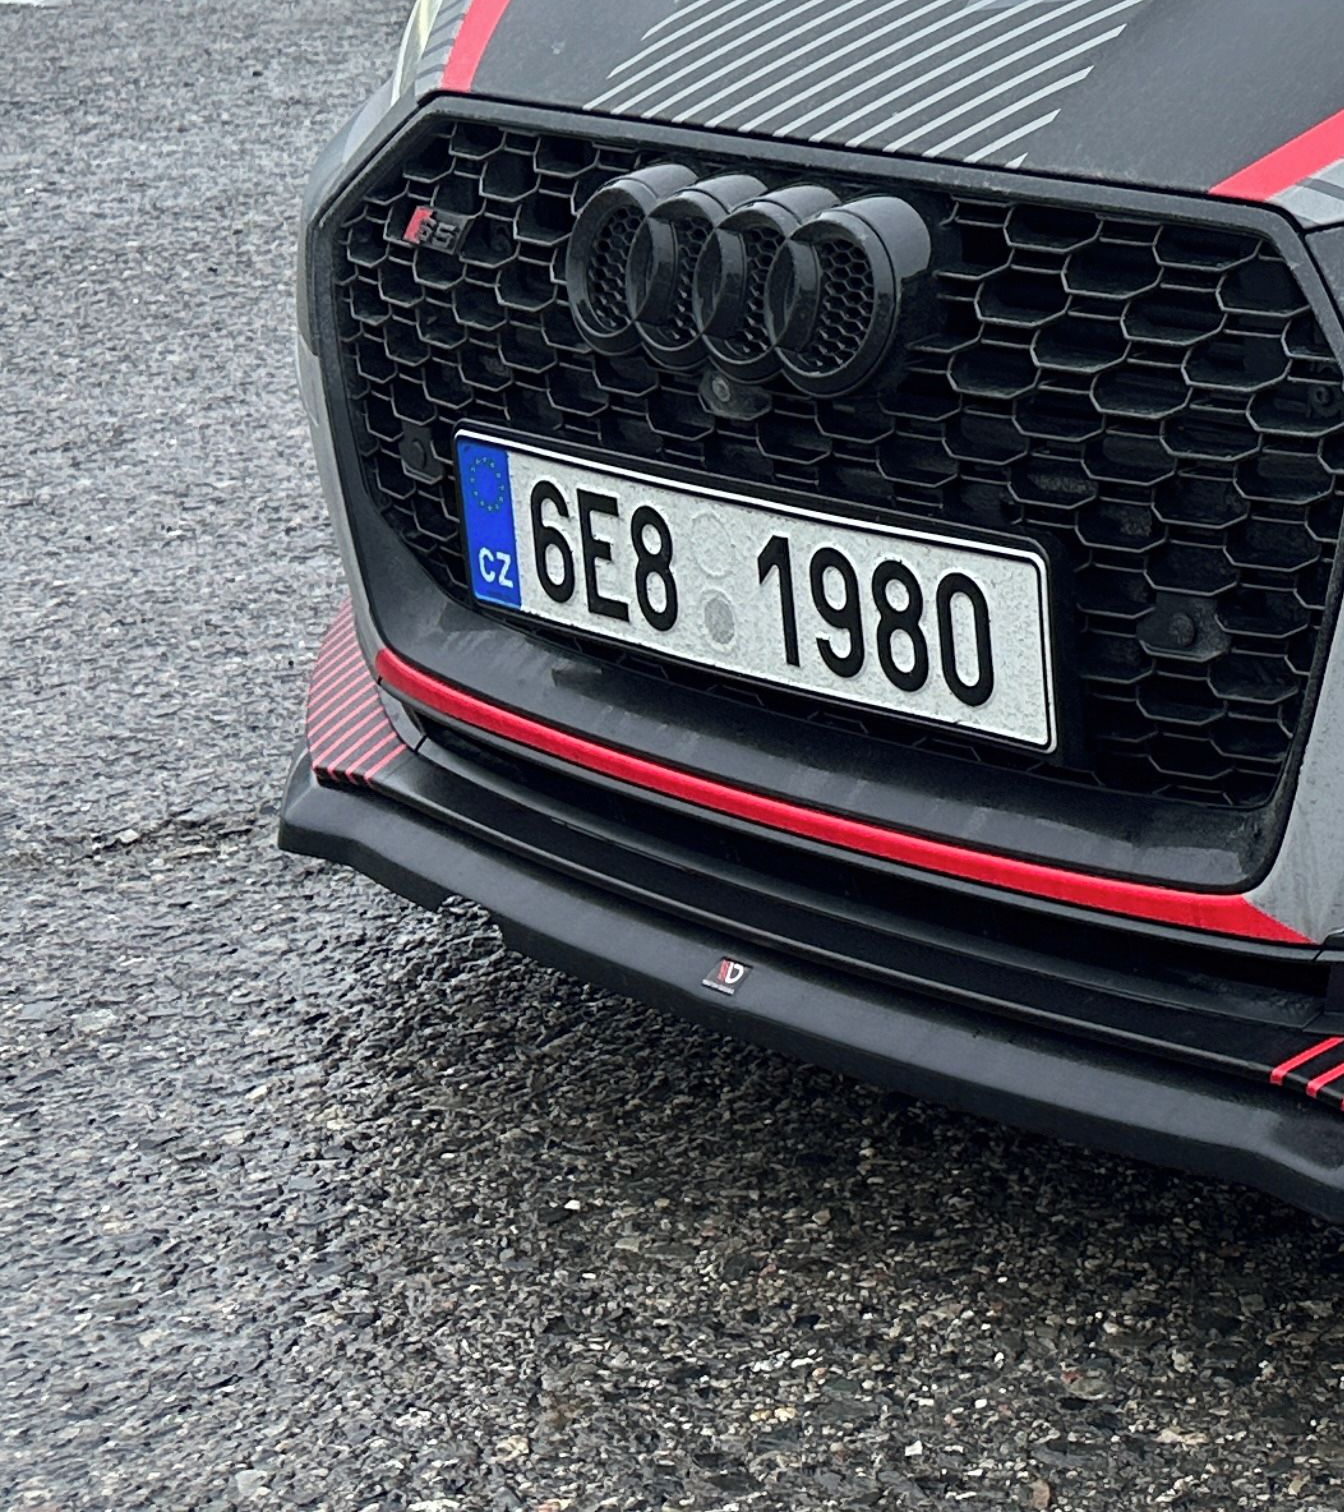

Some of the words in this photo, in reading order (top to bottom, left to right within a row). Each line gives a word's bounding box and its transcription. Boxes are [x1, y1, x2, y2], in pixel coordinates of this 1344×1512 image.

[478, 546, 515, 589] CZ
[530, 479, 679, 633] 6E8
[757, 535, 995, 708] 1980
